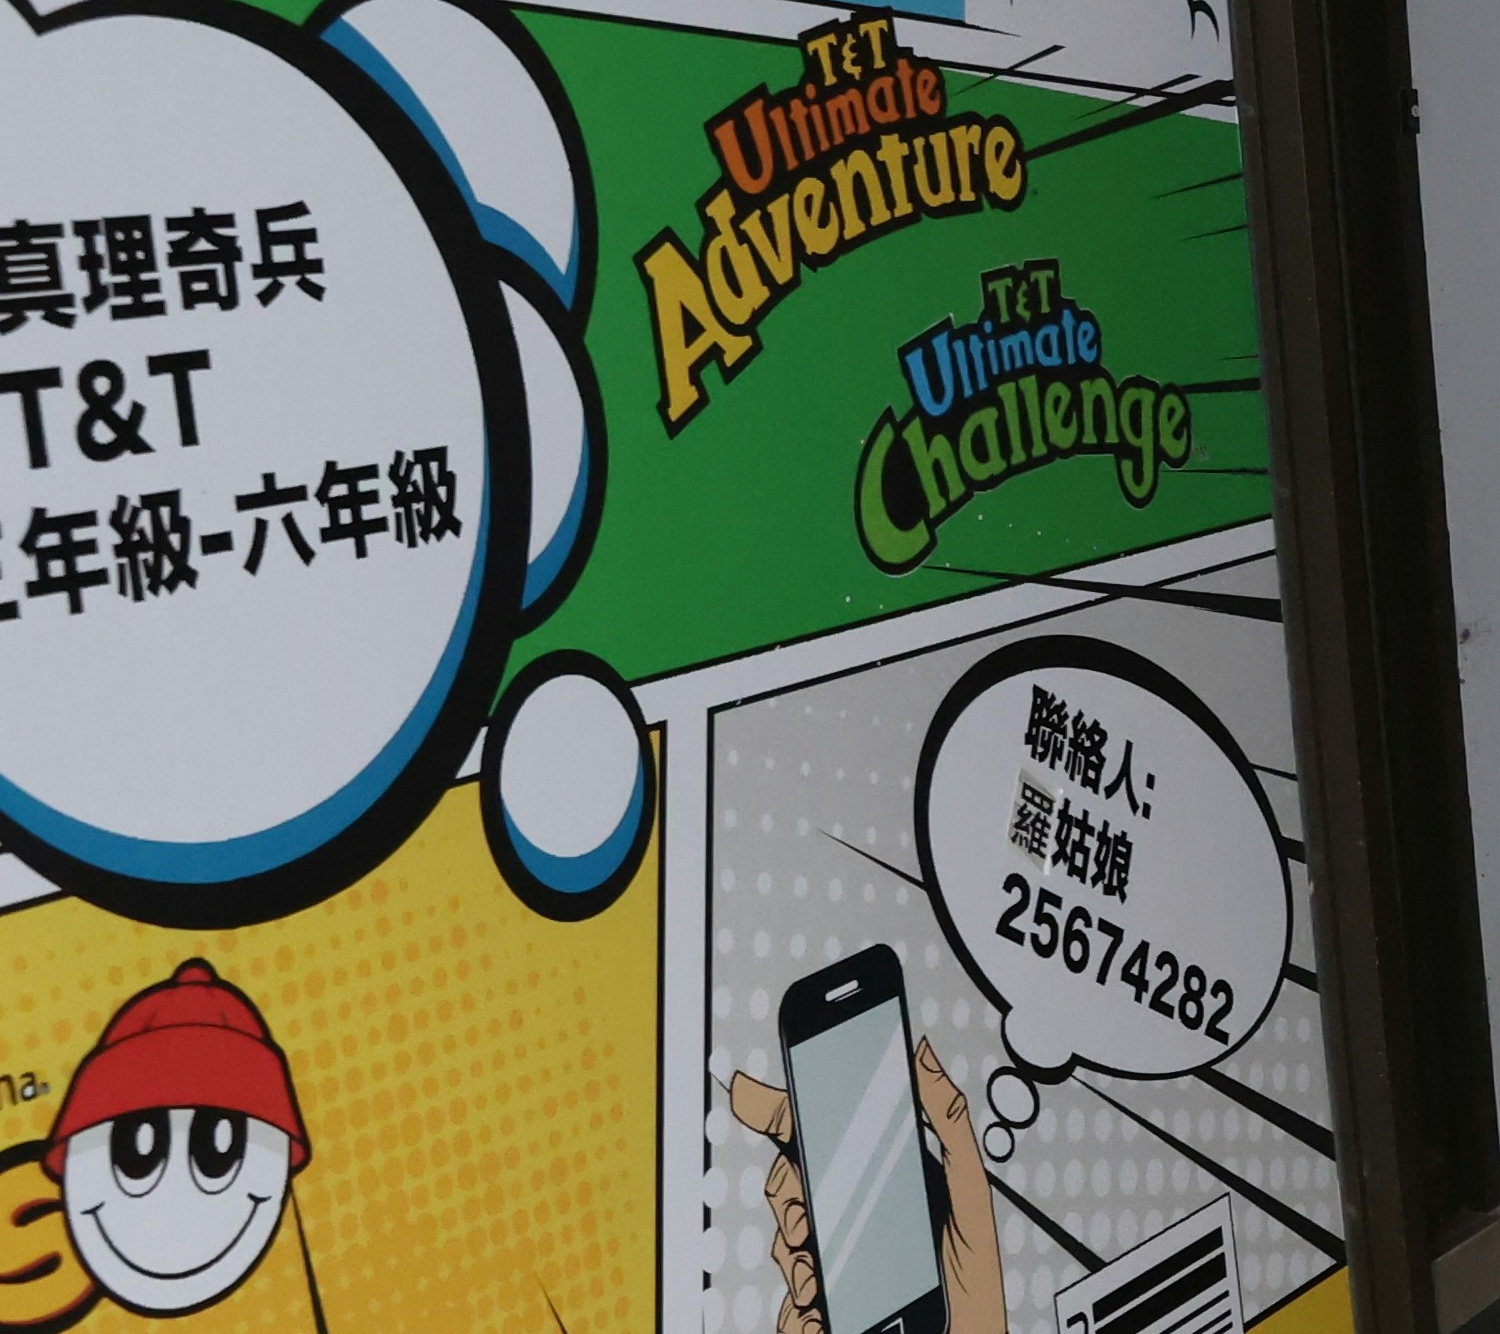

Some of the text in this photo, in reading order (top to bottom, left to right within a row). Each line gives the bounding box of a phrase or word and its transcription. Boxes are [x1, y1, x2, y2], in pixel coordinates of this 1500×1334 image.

[807, 19, 891, 87] T&T
[713, 58, 942, 195] Ultimate
[0, 200, 326, 335] 真理奇兵
[643, 123, 1023, 423] Adventure
[988, 269, 1055, 324] T&T
[0, 349, 212, 469] T&T
[904, 309, 1098, 417] Ultimate
[0, 445, 462, 621] 年級-六年級
[860, 374, 1188, 565] Challenge
[1011, 781, 1134, 905] 羅姑娘
[995, 872, 1234, 1046] 25674282
